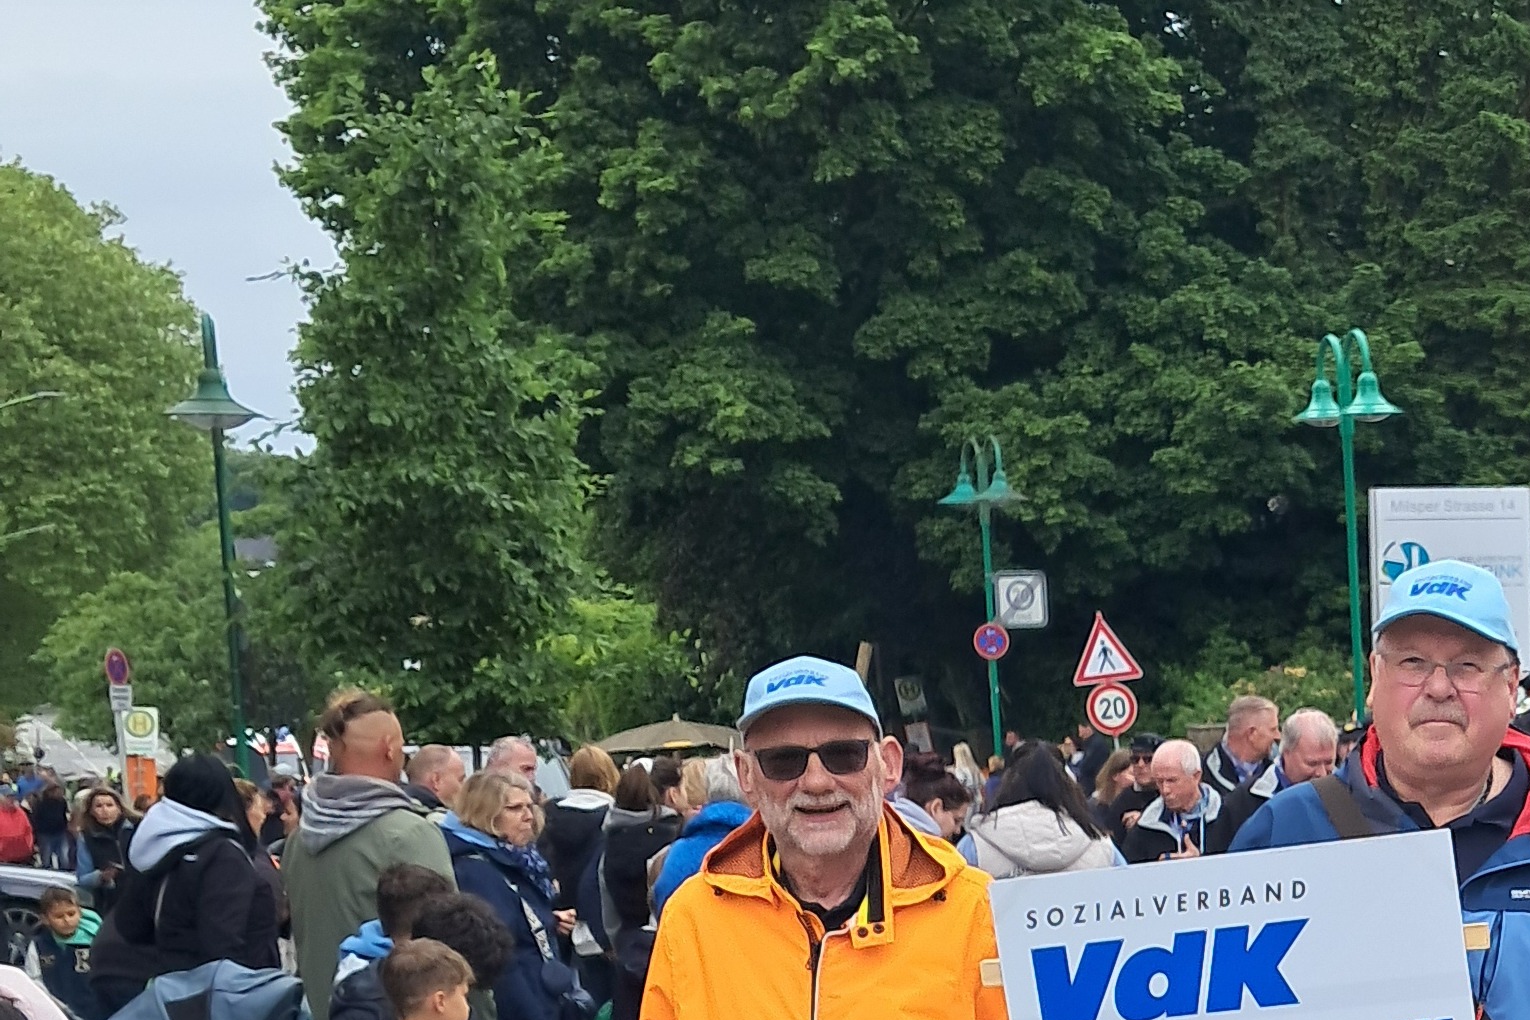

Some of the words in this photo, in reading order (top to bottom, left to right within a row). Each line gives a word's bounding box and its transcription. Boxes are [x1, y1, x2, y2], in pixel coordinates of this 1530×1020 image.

[1444, 498, 1494, 513] Strasse
[1500, 498, 1515, 511] 14
[1099, 696, 1126, 720] 20
[1025, 879, 1309, 930] SOZIALVERBAND
